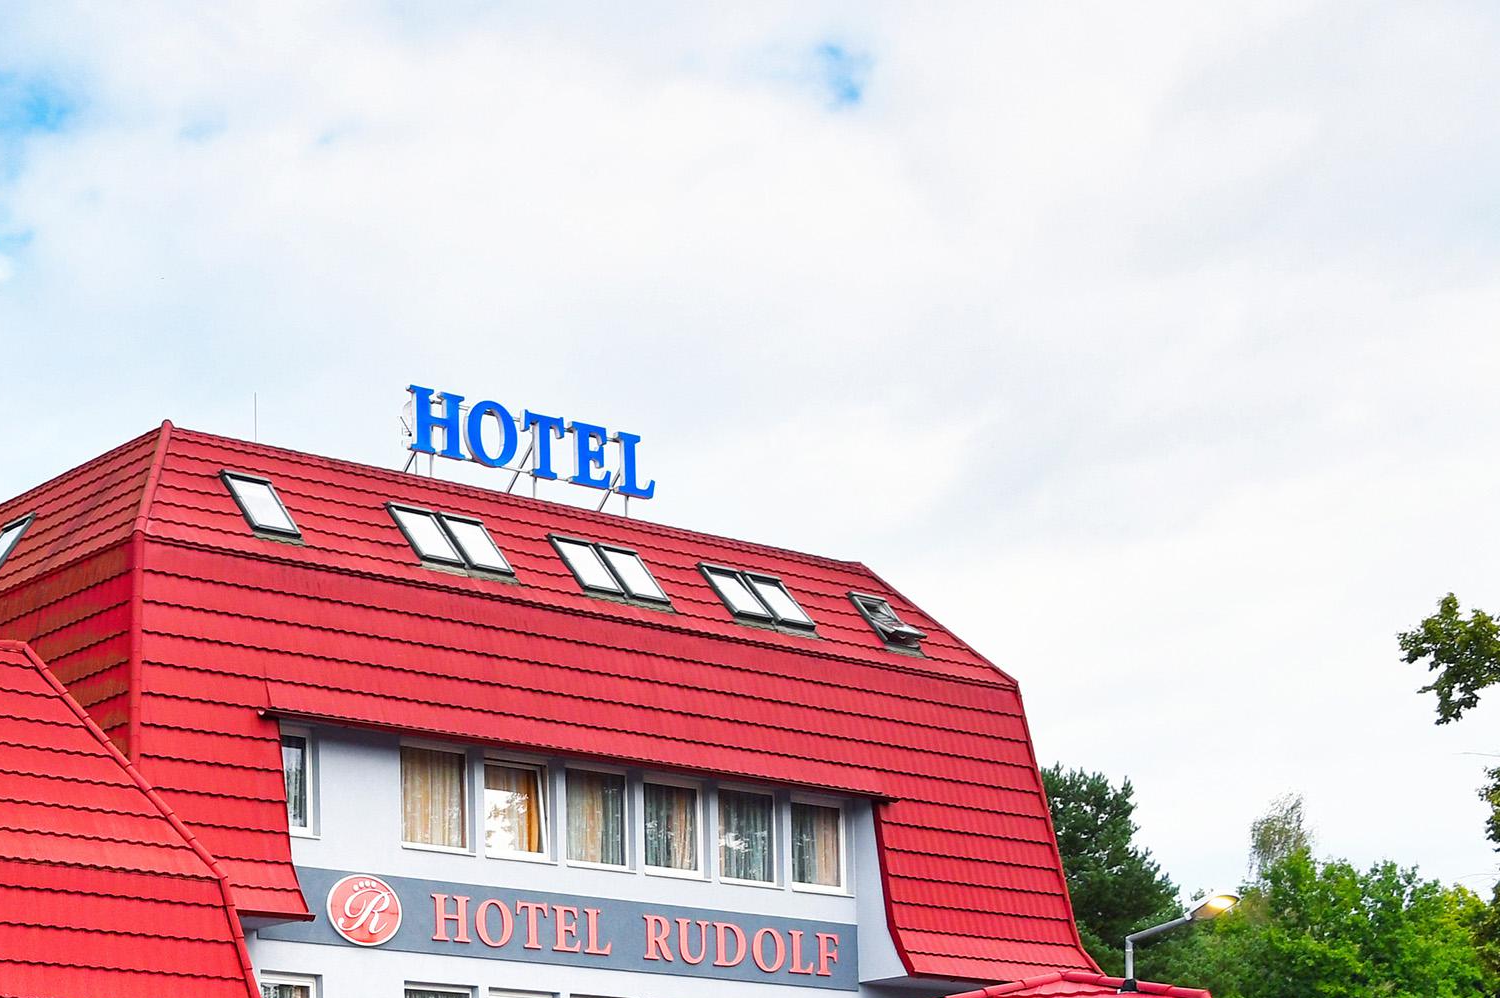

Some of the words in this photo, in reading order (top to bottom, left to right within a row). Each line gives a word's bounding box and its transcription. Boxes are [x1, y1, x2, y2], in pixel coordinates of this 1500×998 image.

[406, 384, 656, 499] HOTEL
[430, 893, 612, 956] HOTEL
[643, 913, 840, 977] RUDOLF
